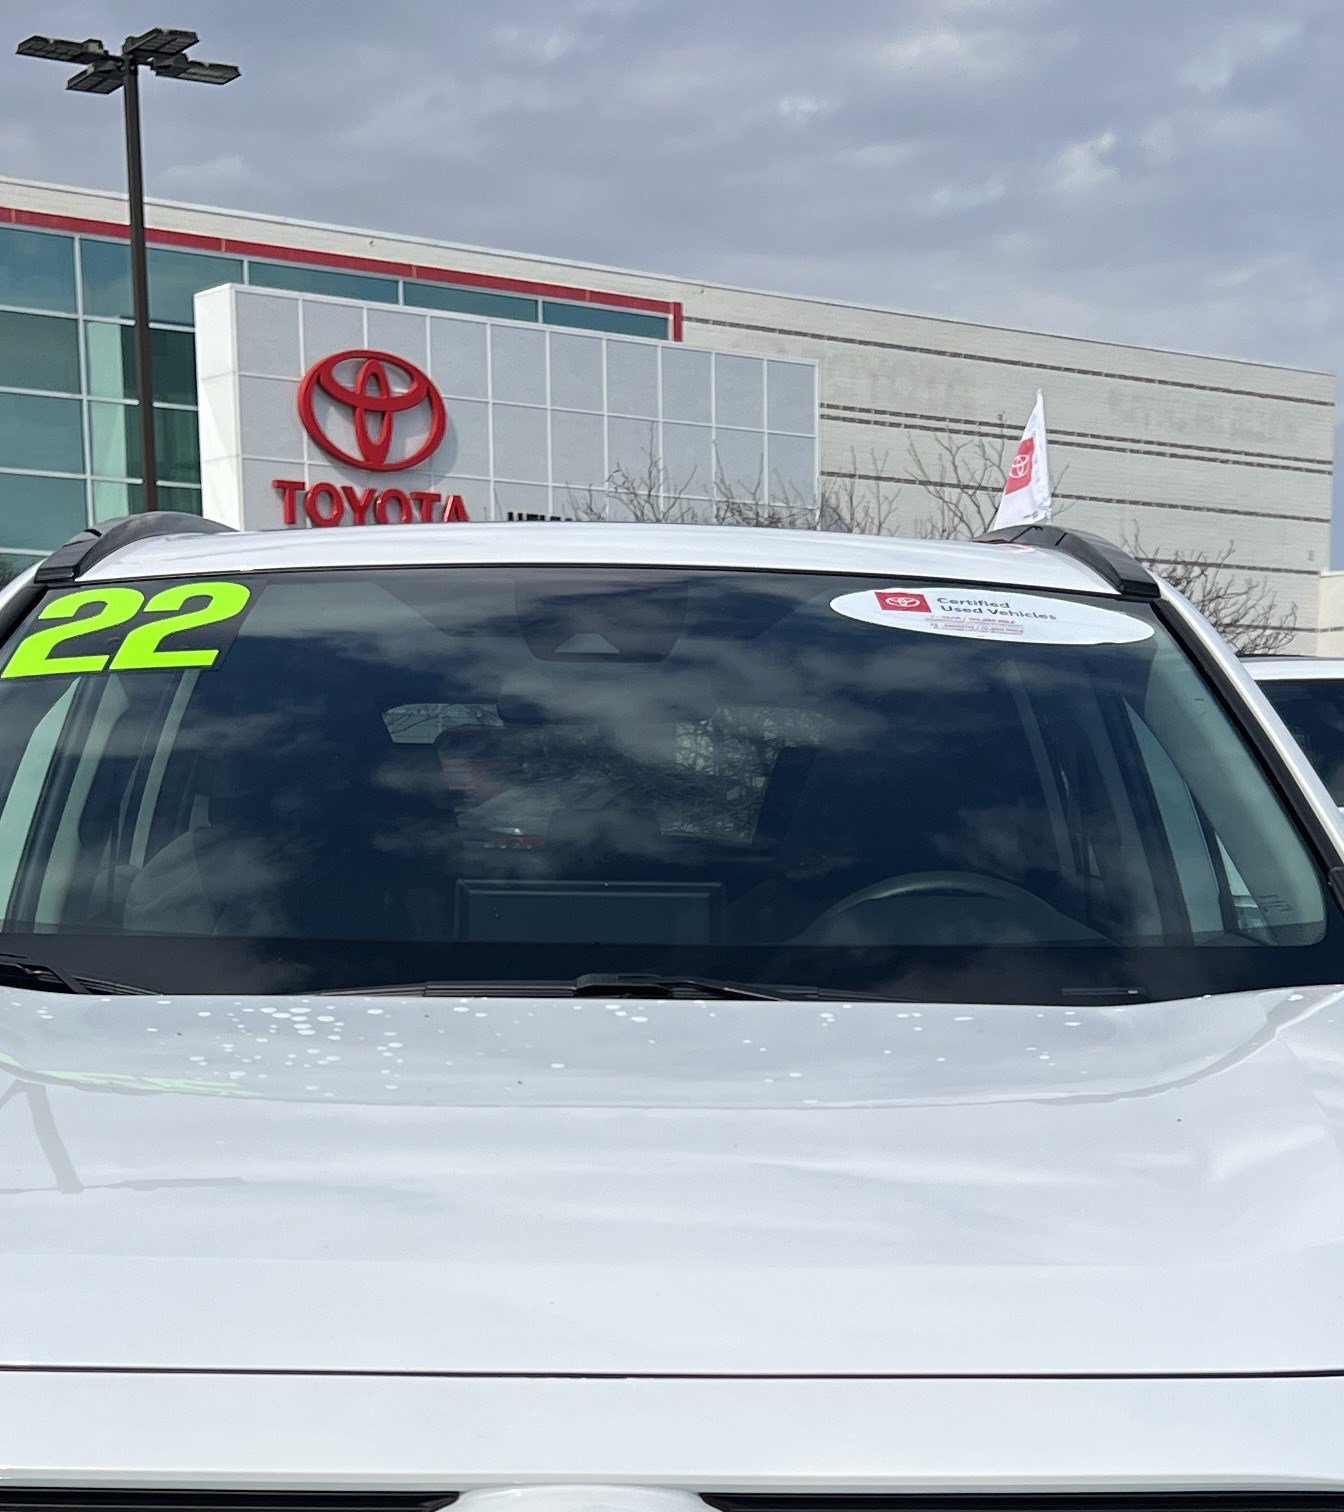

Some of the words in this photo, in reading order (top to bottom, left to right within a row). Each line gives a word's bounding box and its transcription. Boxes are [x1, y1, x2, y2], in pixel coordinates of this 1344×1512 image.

[272, 480, 469, 527] TOYOTA
[937, 597, 1011, 609] Certified
[940, 605, 984, 614] Used
[987, 608, 1057, 620] Vehicles
[0, 581, 251, 679] 22
